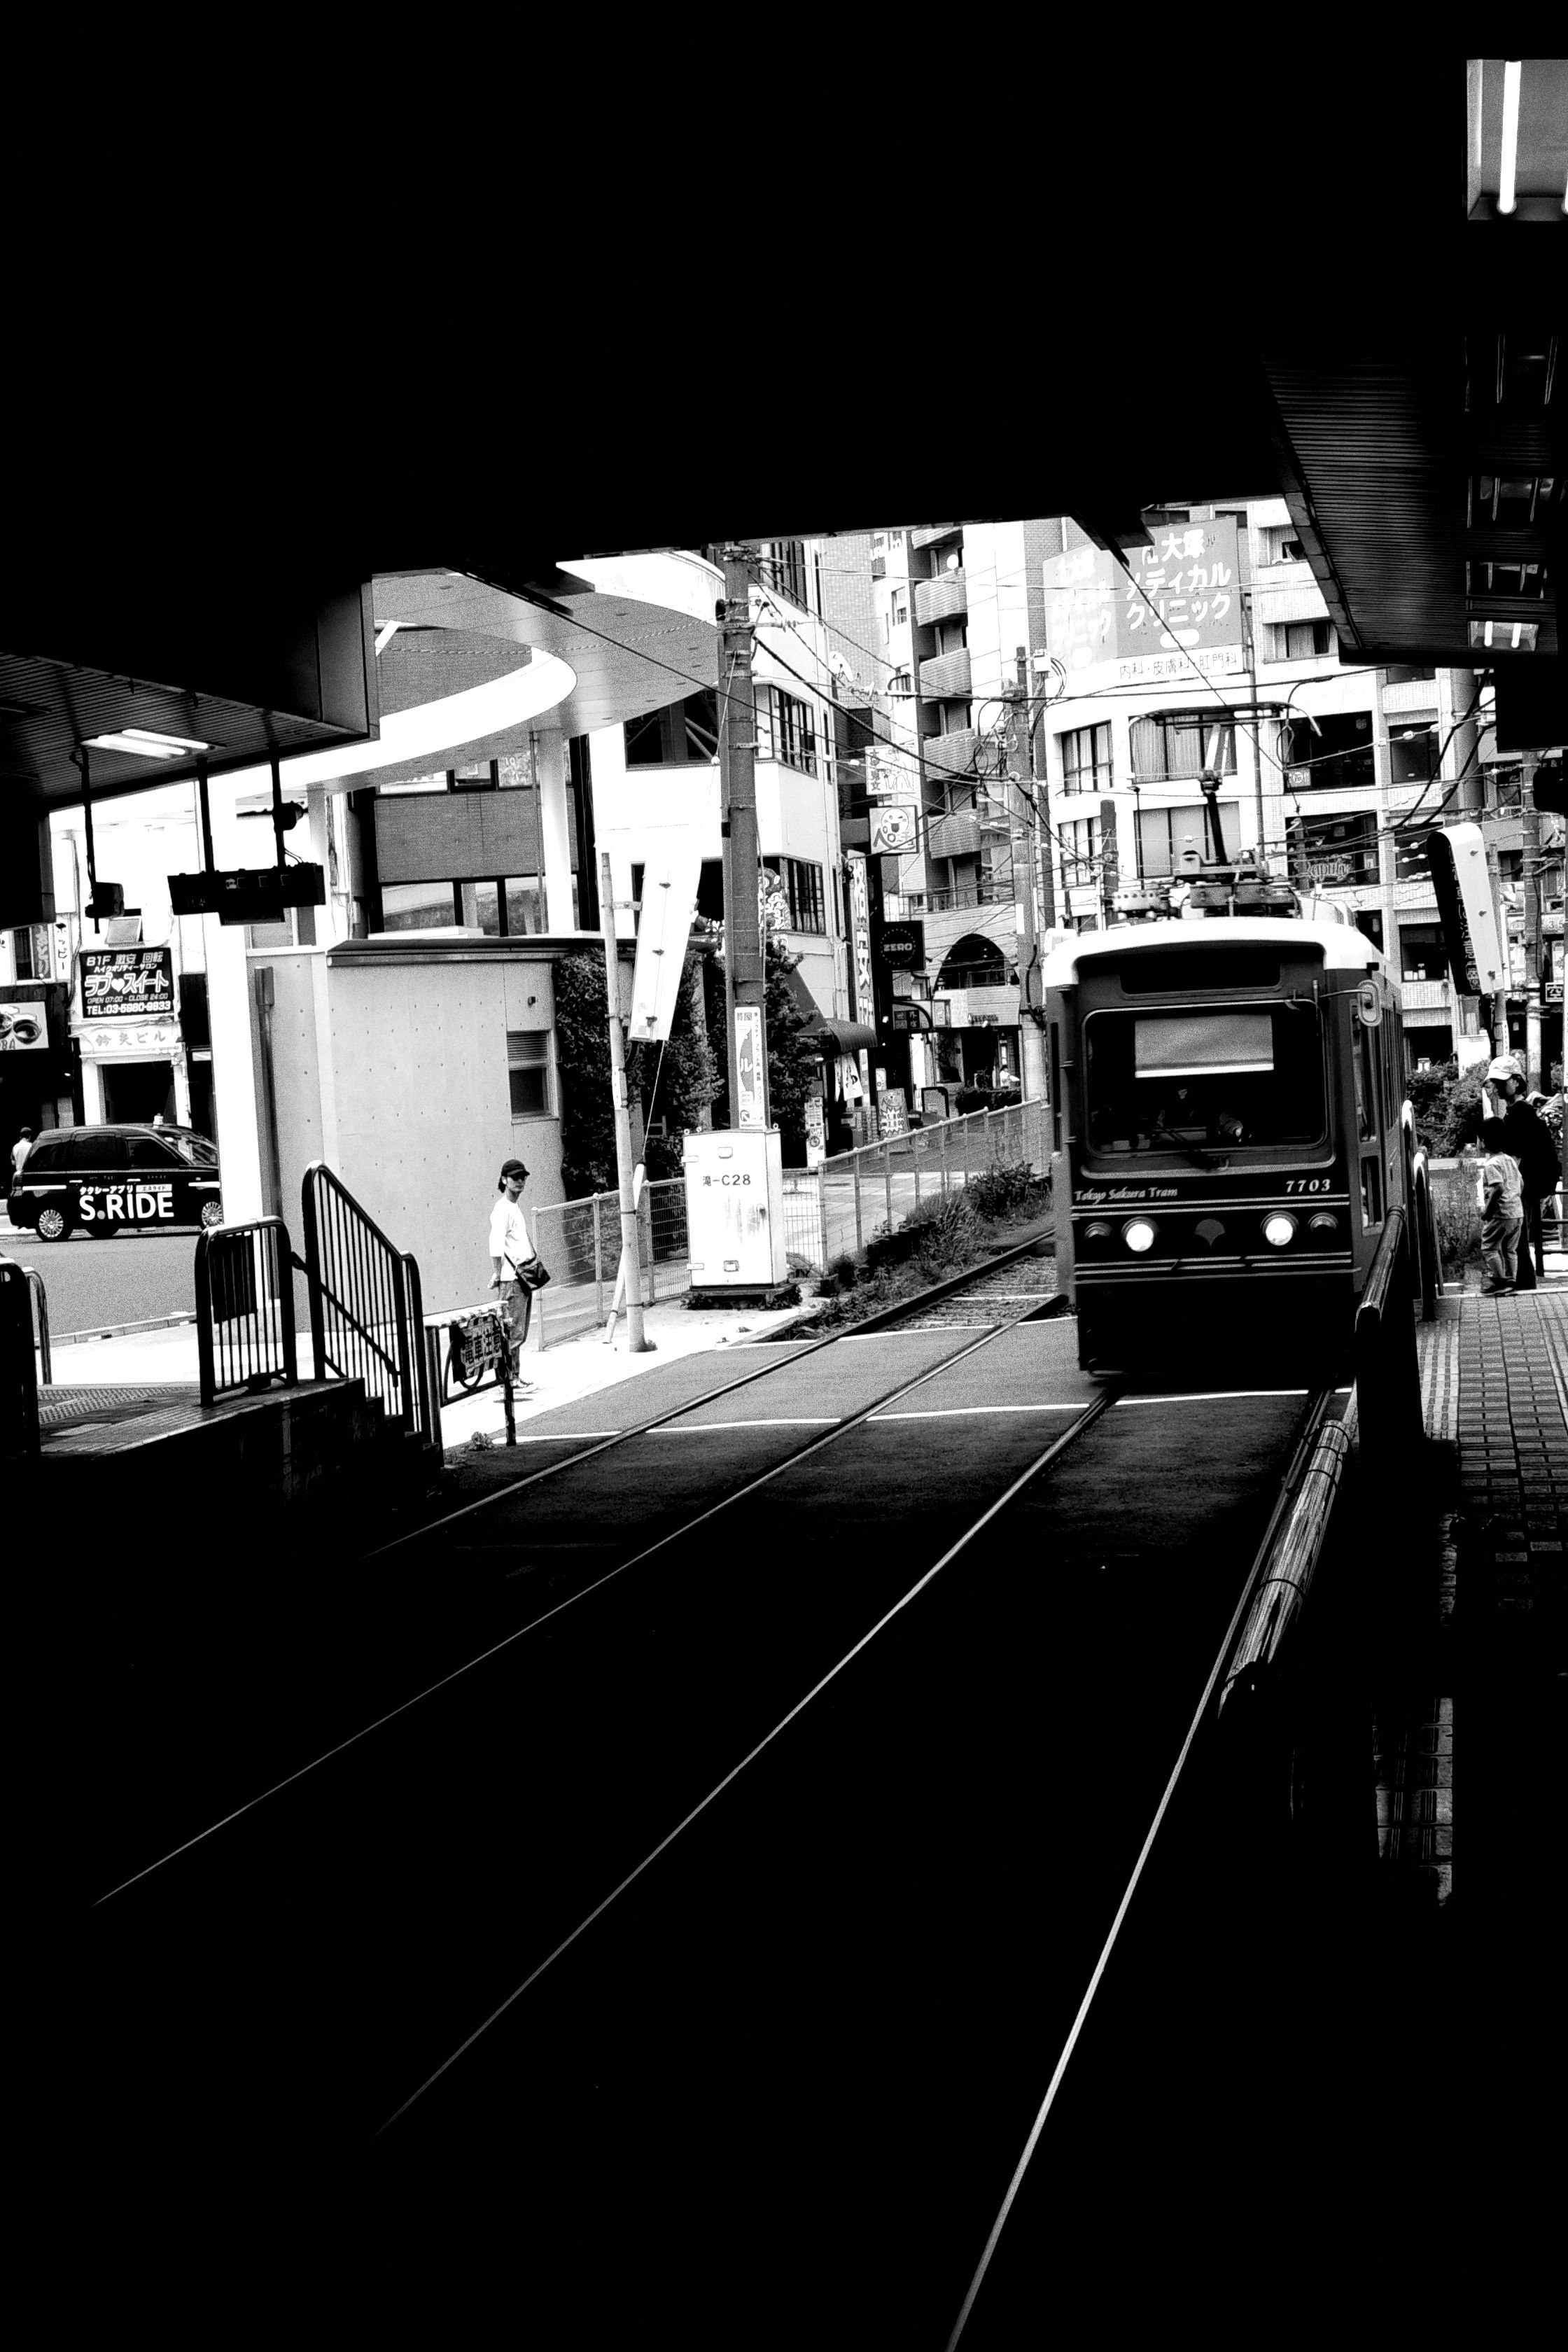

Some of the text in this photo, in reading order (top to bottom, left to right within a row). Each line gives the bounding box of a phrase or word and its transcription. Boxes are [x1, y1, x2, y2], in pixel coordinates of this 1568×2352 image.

[1126, 561, 1231, 601] メディカル
[1126, 592, 1231, 630] クリニック
[55, 923, 68, 970] ホッピー
[883, 943, 913, 951] ZERO
[87, 955, 111, 966] B1F
[1074, 1186, 1178, 1205] Tokyo Sakura Tram
[1285, 1178, 1331, 1193] 7703
[79, 1192, 174, 1220] S.RIDE
